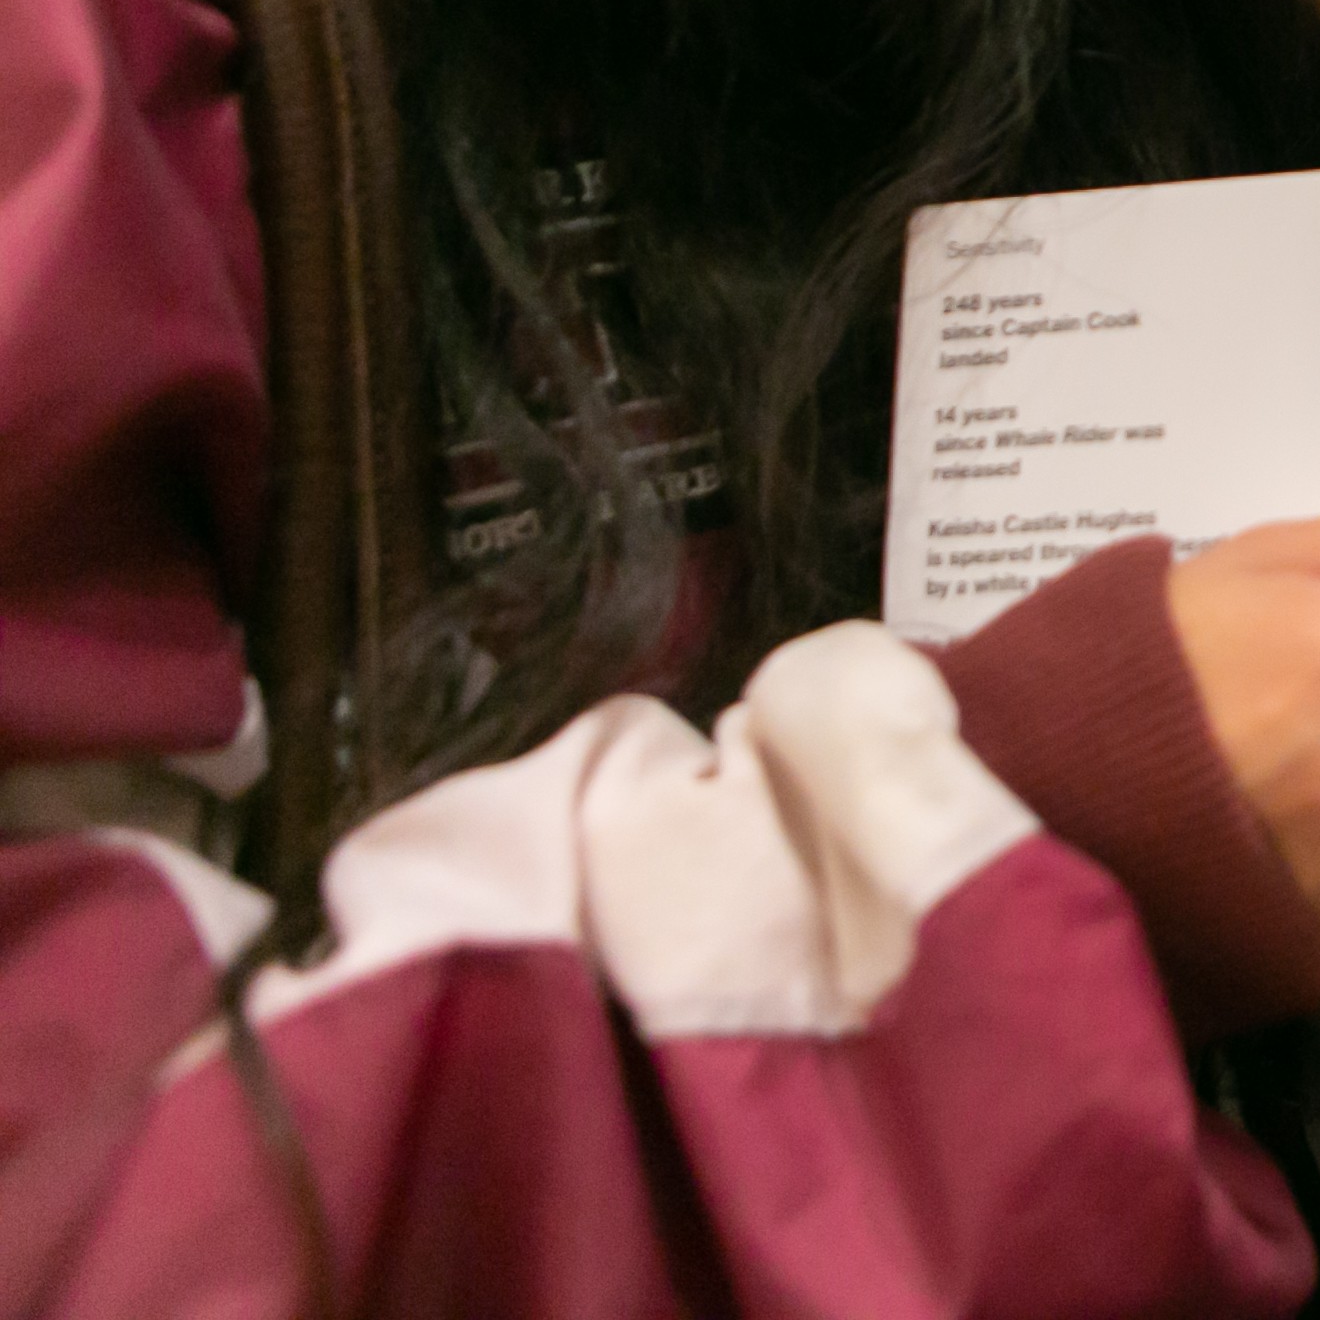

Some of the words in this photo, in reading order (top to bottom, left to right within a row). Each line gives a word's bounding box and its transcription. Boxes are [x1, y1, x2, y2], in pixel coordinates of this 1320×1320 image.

[988, 292, 1043, 313] years
[942, 324, 994, 341] since
[1001, 317, 1080, 338] Captain
[1087, 309, 1141, 330] Cook
[939, 348, 1009, 368] landed
[935, 406, 956, 424] 14
[962, 405, 1018, 425] years
[934, 436, 987, 452] since
[995, 430, 1055, 448] Whale
[1062, 425, 1117, 443] Rider
[1124, 424, 1165, 439] was
[932, 459, 1022, 479] released
[928, 519, 997, 537] Keisha
[1003, 514, 1069, 532] Castle
[1076, 509, 1156, 530] Hughes
[926, 549, 942, 567] is
[949, 545, 1033, 566] speared
[926, 580, 948, 598] by
[956, 580, 968, 594] a
